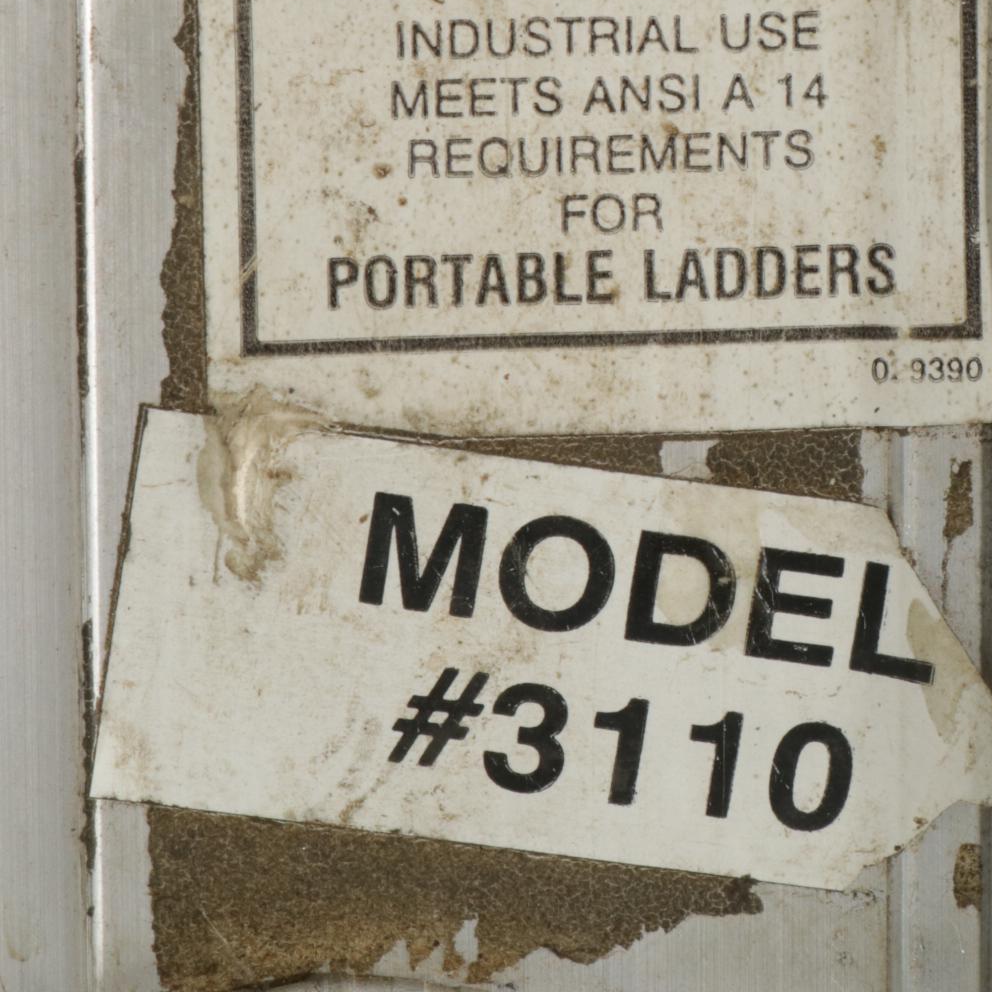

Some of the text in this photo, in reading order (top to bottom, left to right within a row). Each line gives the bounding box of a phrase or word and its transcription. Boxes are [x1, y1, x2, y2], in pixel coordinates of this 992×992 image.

[395, 10, 820, 60] INDUSTRIAL USE
[390, 73, 828, 119] MEETS ANSI A 14
[407, 130, 815, 179] REQUIREMENTS
[561, 193, 664, 234] FOR
[327, 243, 896, 311] PORTABLE LADDERS
[359, 492, 935, 684] MODEL
[388, 668, 854, 833] #3110
